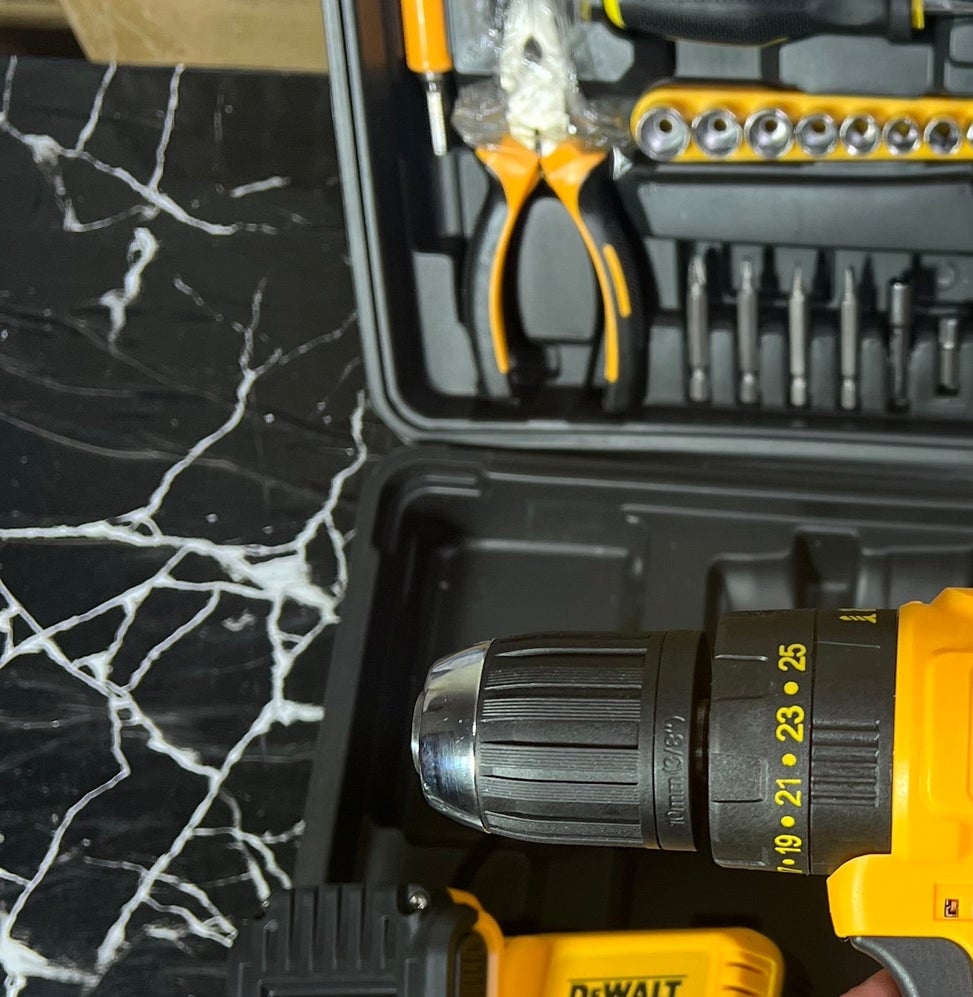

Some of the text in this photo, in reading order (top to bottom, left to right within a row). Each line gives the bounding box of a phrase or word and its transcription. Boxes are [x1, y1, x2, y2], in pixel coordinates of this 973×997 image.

[777, 643, 808, 672] 25
[775, 704, 806, 742] 23
[774, 778, 803, 807] 21
[774, 834, 802, 854] 19
